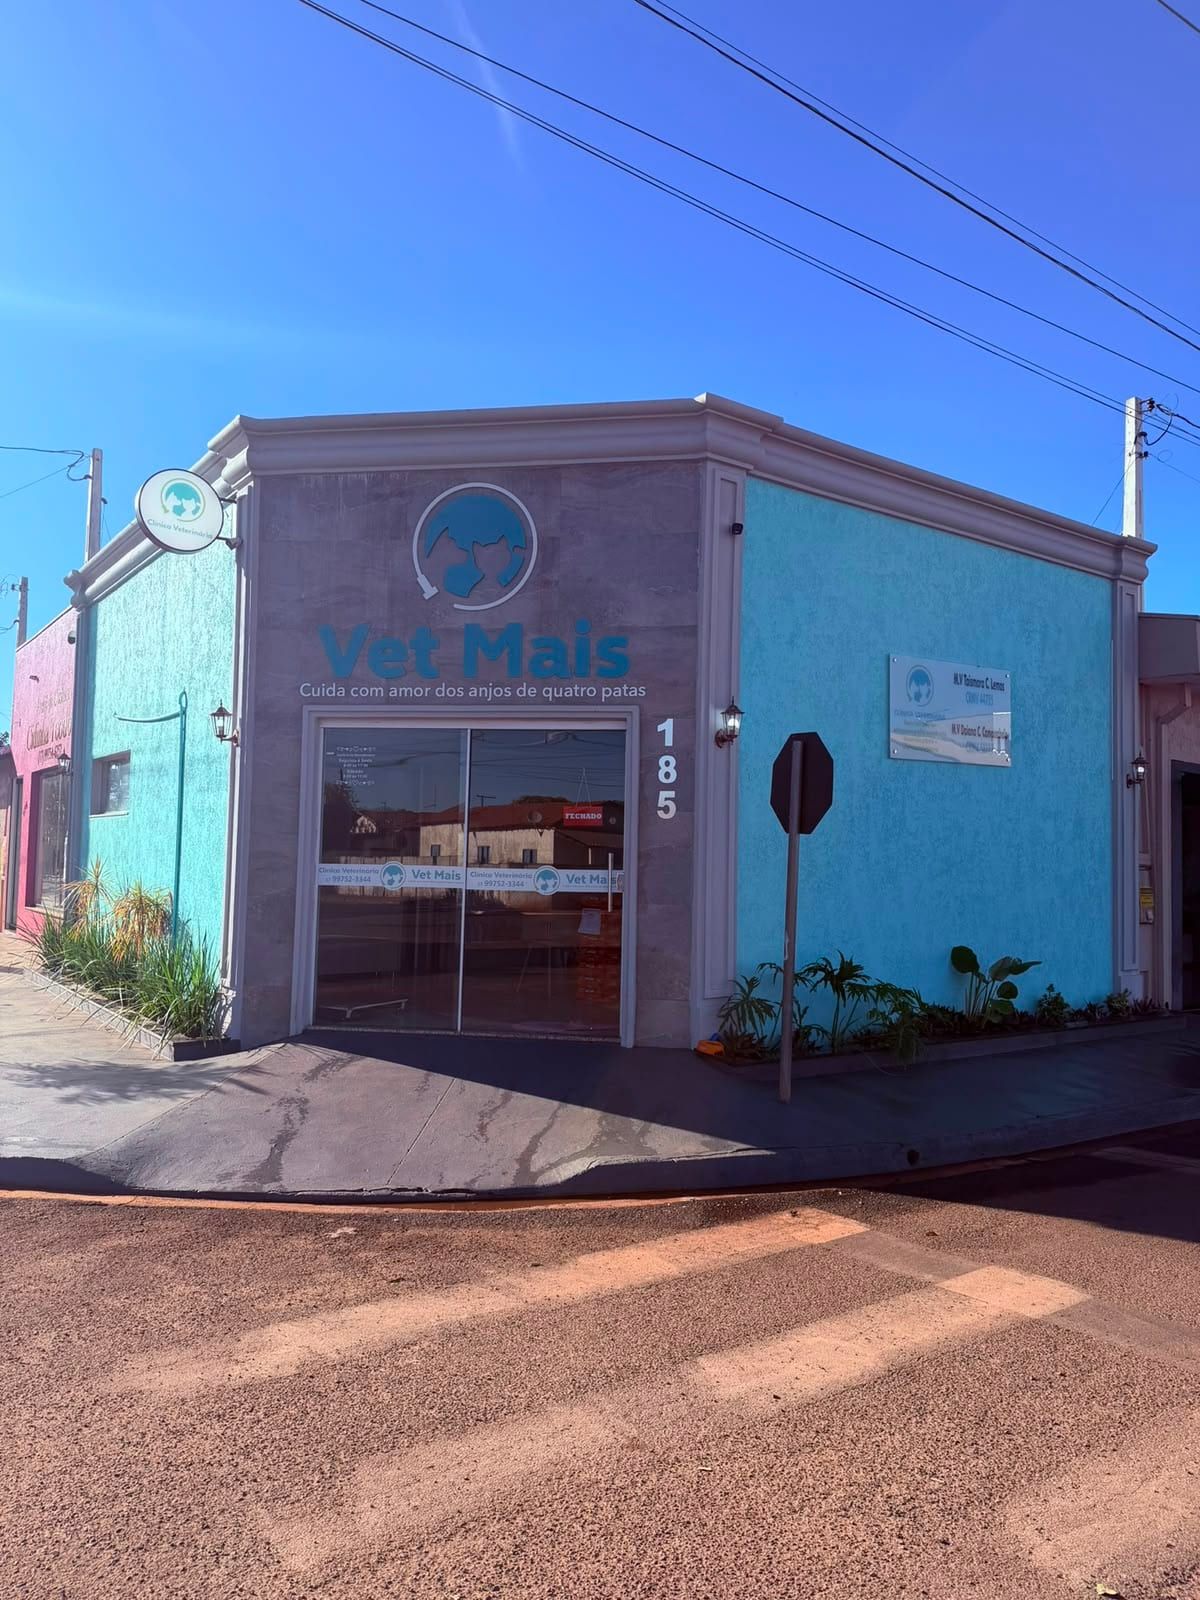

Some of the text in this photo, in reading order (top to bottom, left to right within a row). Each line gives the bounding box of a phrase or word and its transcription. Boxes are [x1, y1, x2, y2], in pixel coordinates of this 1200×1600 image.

[318, 618, 630, 679] Vet Mais
[300, 682, 646, 702] Cuida com amor dos anjos de quatro patas
[565, 812, 602, 820] FECHADO
[411, 868, 432, 881] Vet
[434, 869, 461, 882] Mais
[566, 873, 587, 885] Vet
[589, 874, 617, 886] Mas
